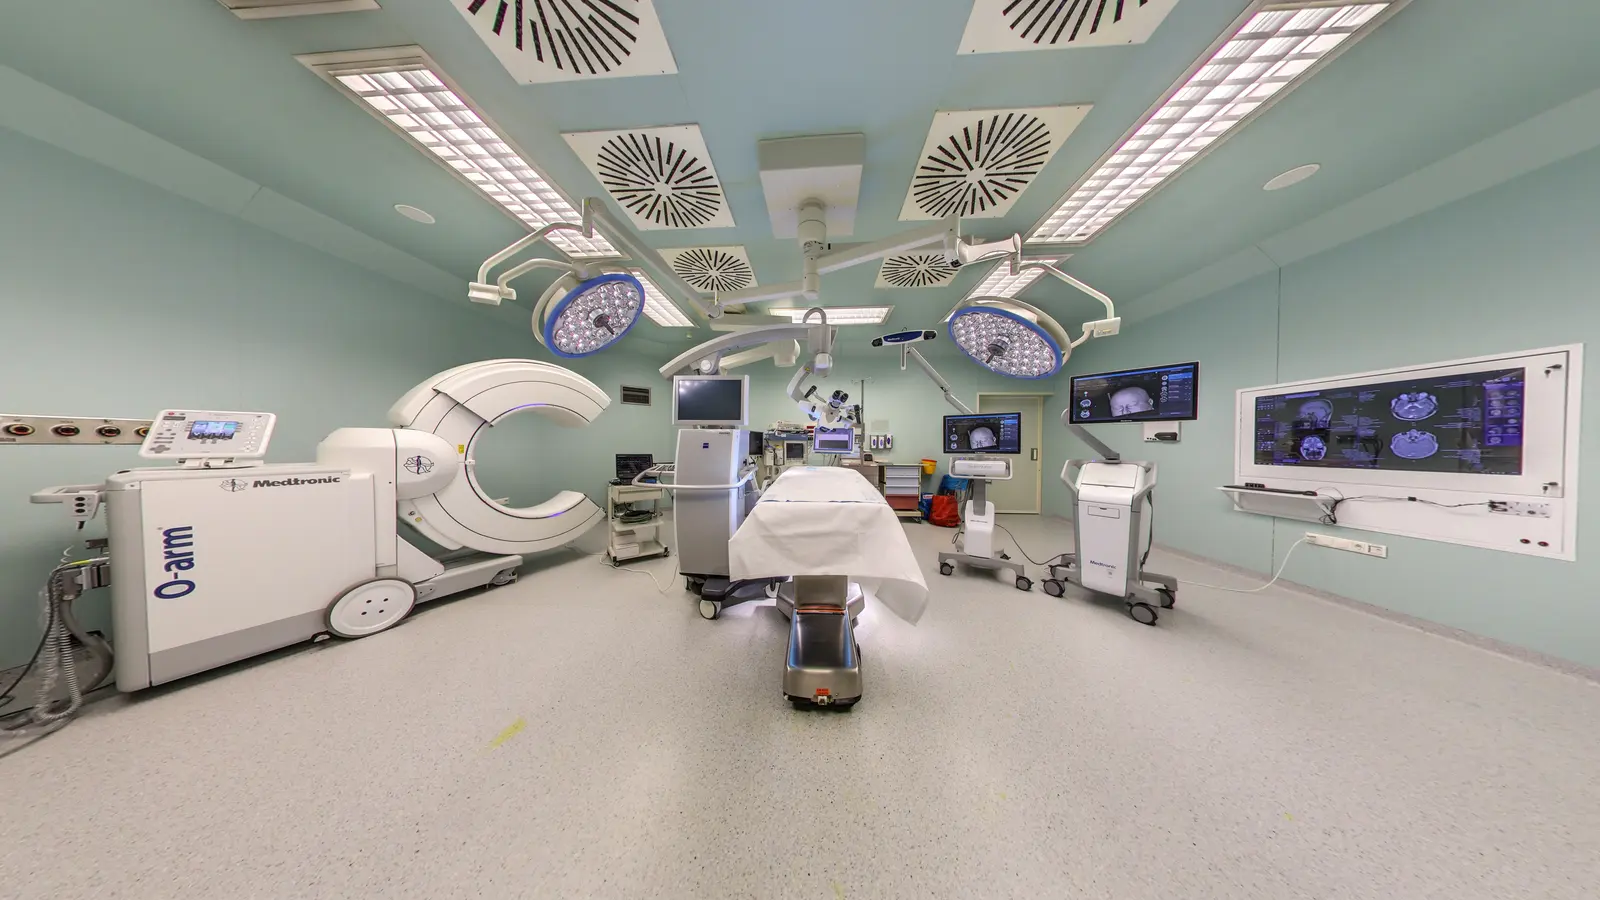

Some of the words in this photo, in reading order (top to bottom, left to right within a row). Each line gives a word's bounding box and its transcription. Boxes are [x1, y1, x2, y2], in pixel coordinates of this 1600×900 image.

[253, 476, 340, 488] Medtronic
[154, 526, 196, 599] O-arm
[1090, 560, 1117, 569] Medtronic
